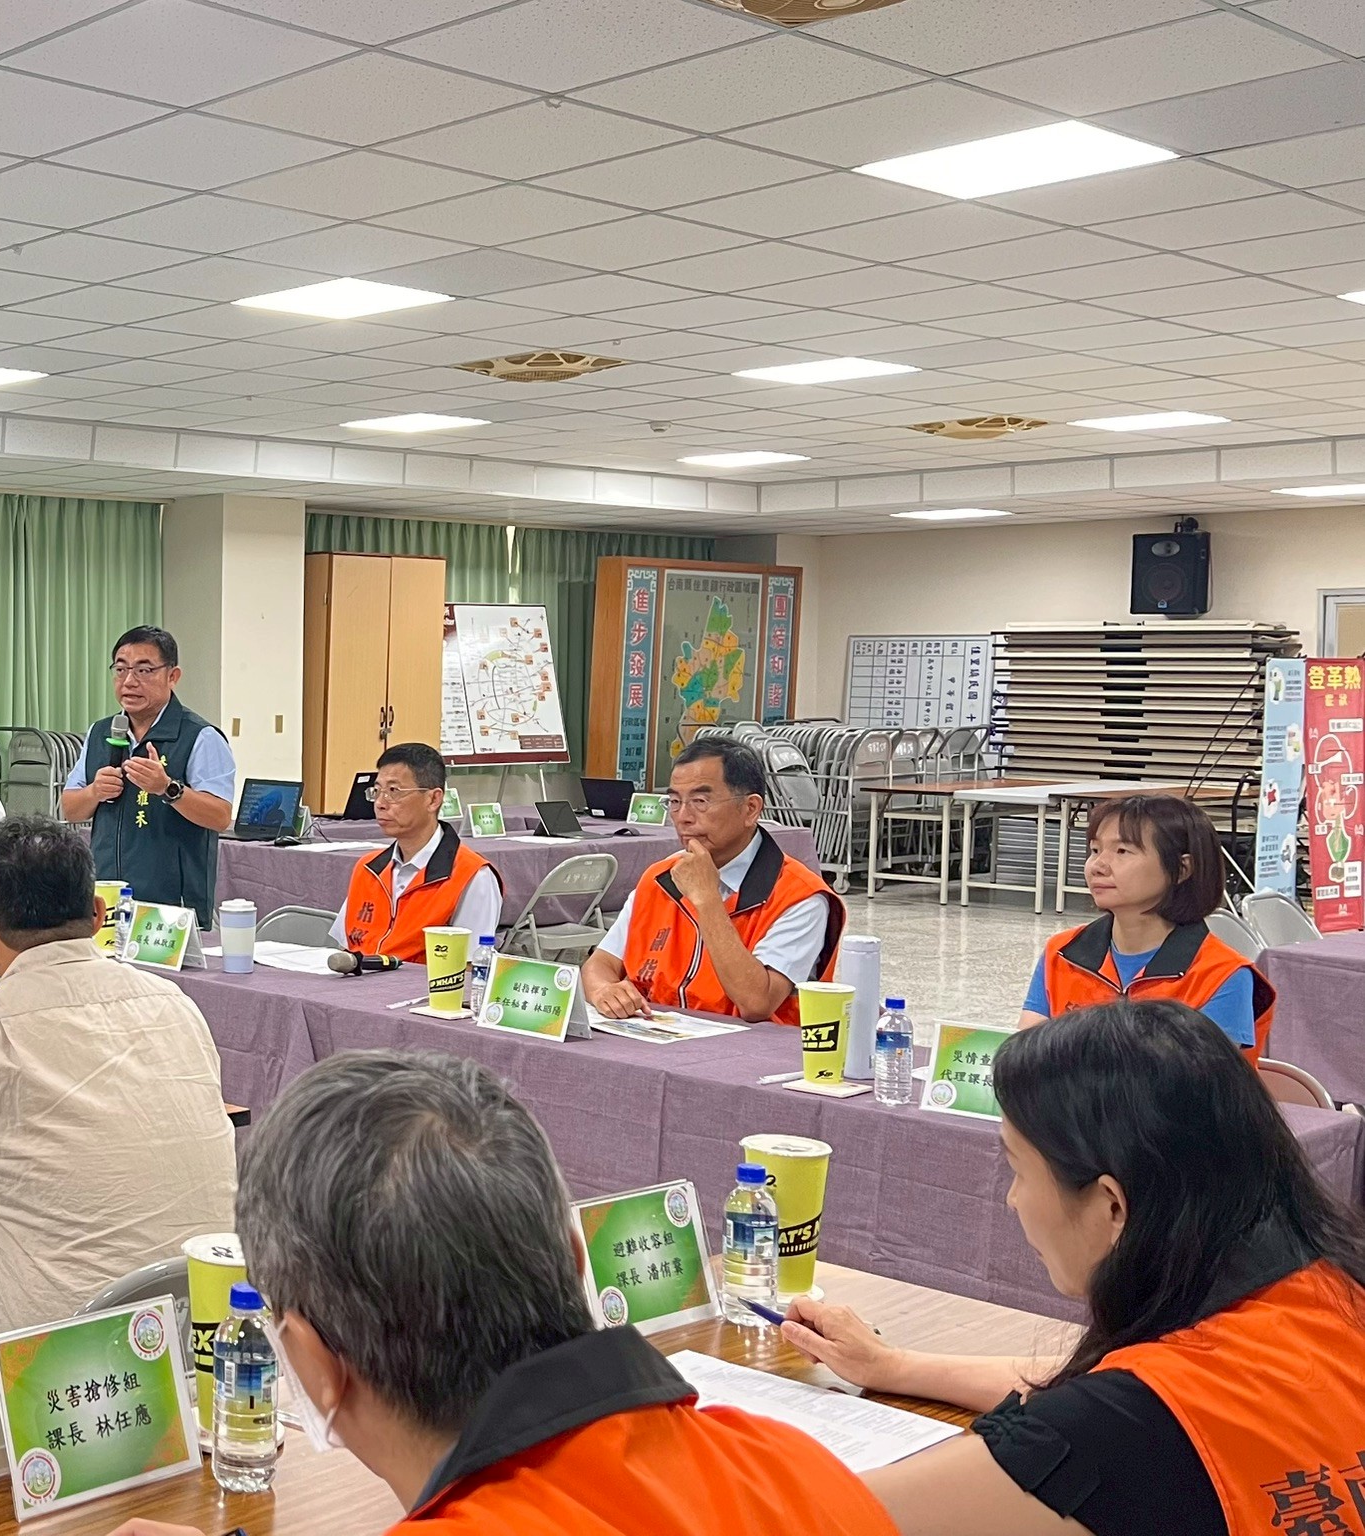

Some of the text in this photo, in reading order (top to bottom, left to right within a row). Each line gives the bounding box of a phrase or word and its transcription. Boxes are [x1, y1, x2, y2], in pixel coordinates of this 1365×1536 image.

[626, 587, 649, 708] 進步發展
[1308, 665, 1361, 690] 登革熱
[513, 983, 549, 996] 副指揮官
[613, 1231, 675, 1257] 避難收容組
[616, 1267, 642, 1288] 課長
[47, 1371, 141, 1414] 災害搶修組
[45, 1421, 87, 1451] 課長
